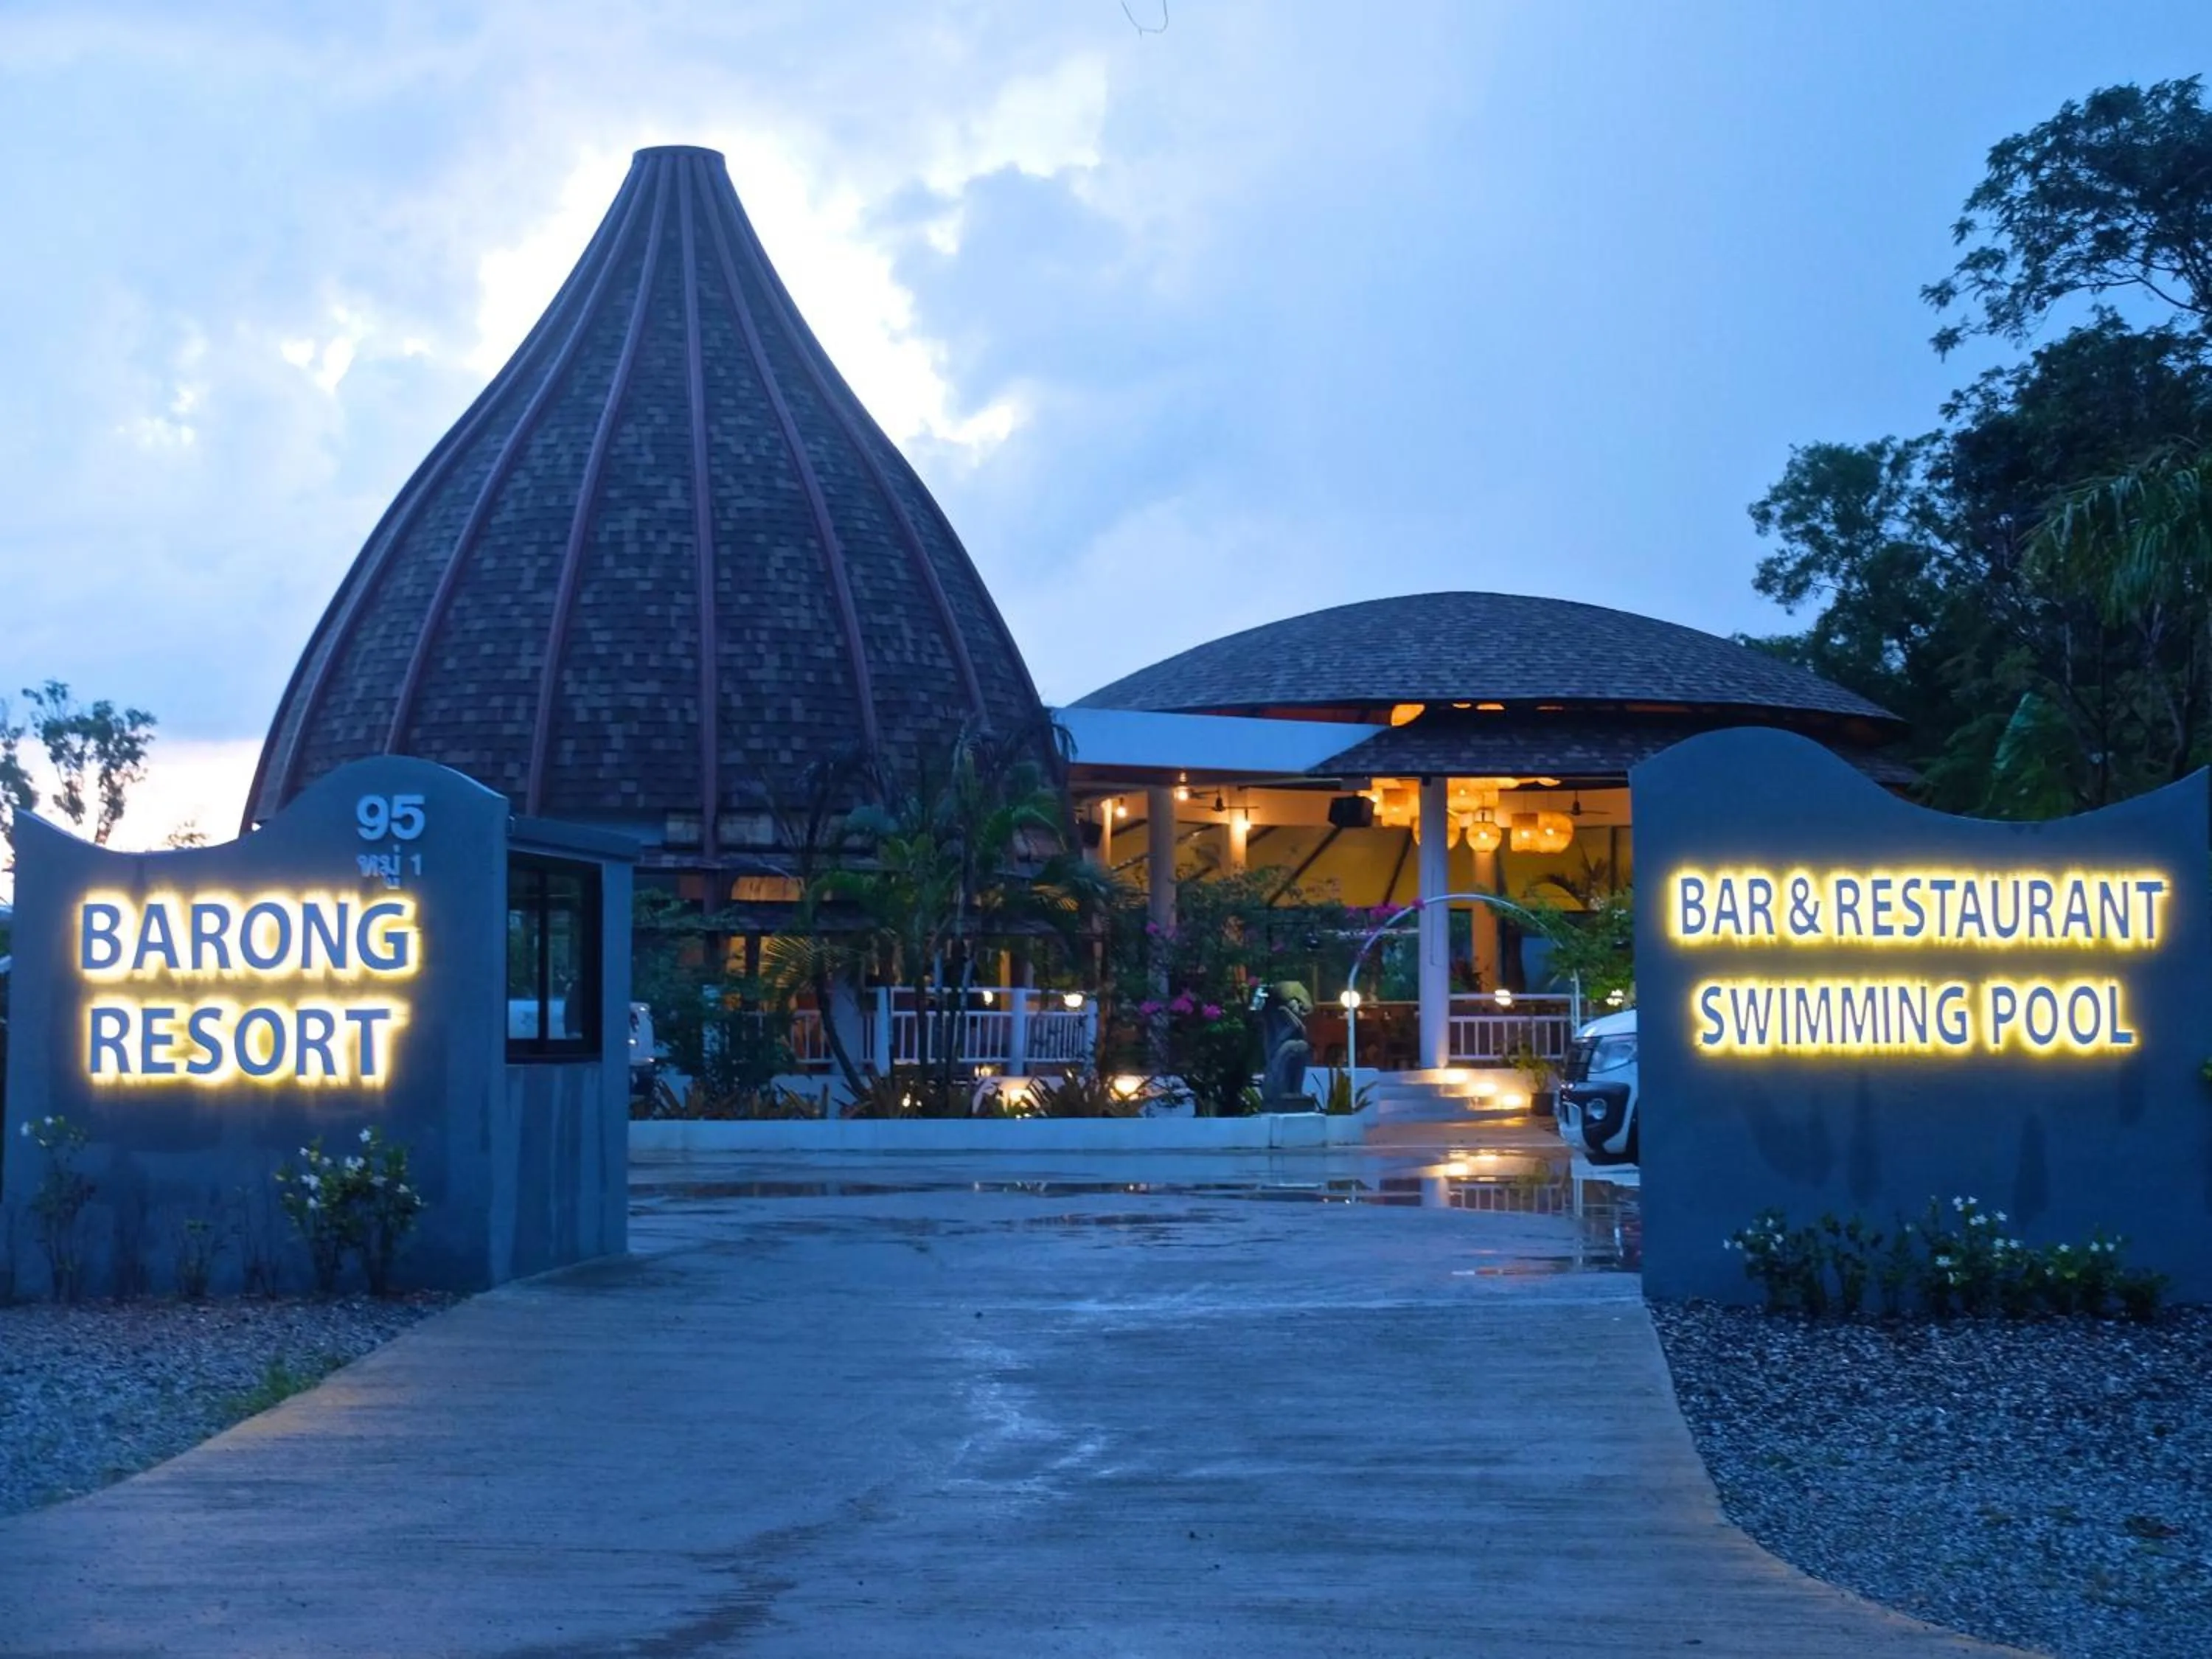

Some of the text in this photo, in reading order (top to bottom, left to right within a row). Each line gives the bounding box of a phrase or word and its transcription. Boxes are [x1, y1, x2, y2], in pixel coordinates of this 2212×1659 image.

[356, 794, 425, 841] 95
[410, 854, 422, 876] 1
[81, 902, 409, 971] BARONG
[90, 1006, 392, 1077] RESORT
[1701, 986, 2132, 1046] SWIMMING POOL
